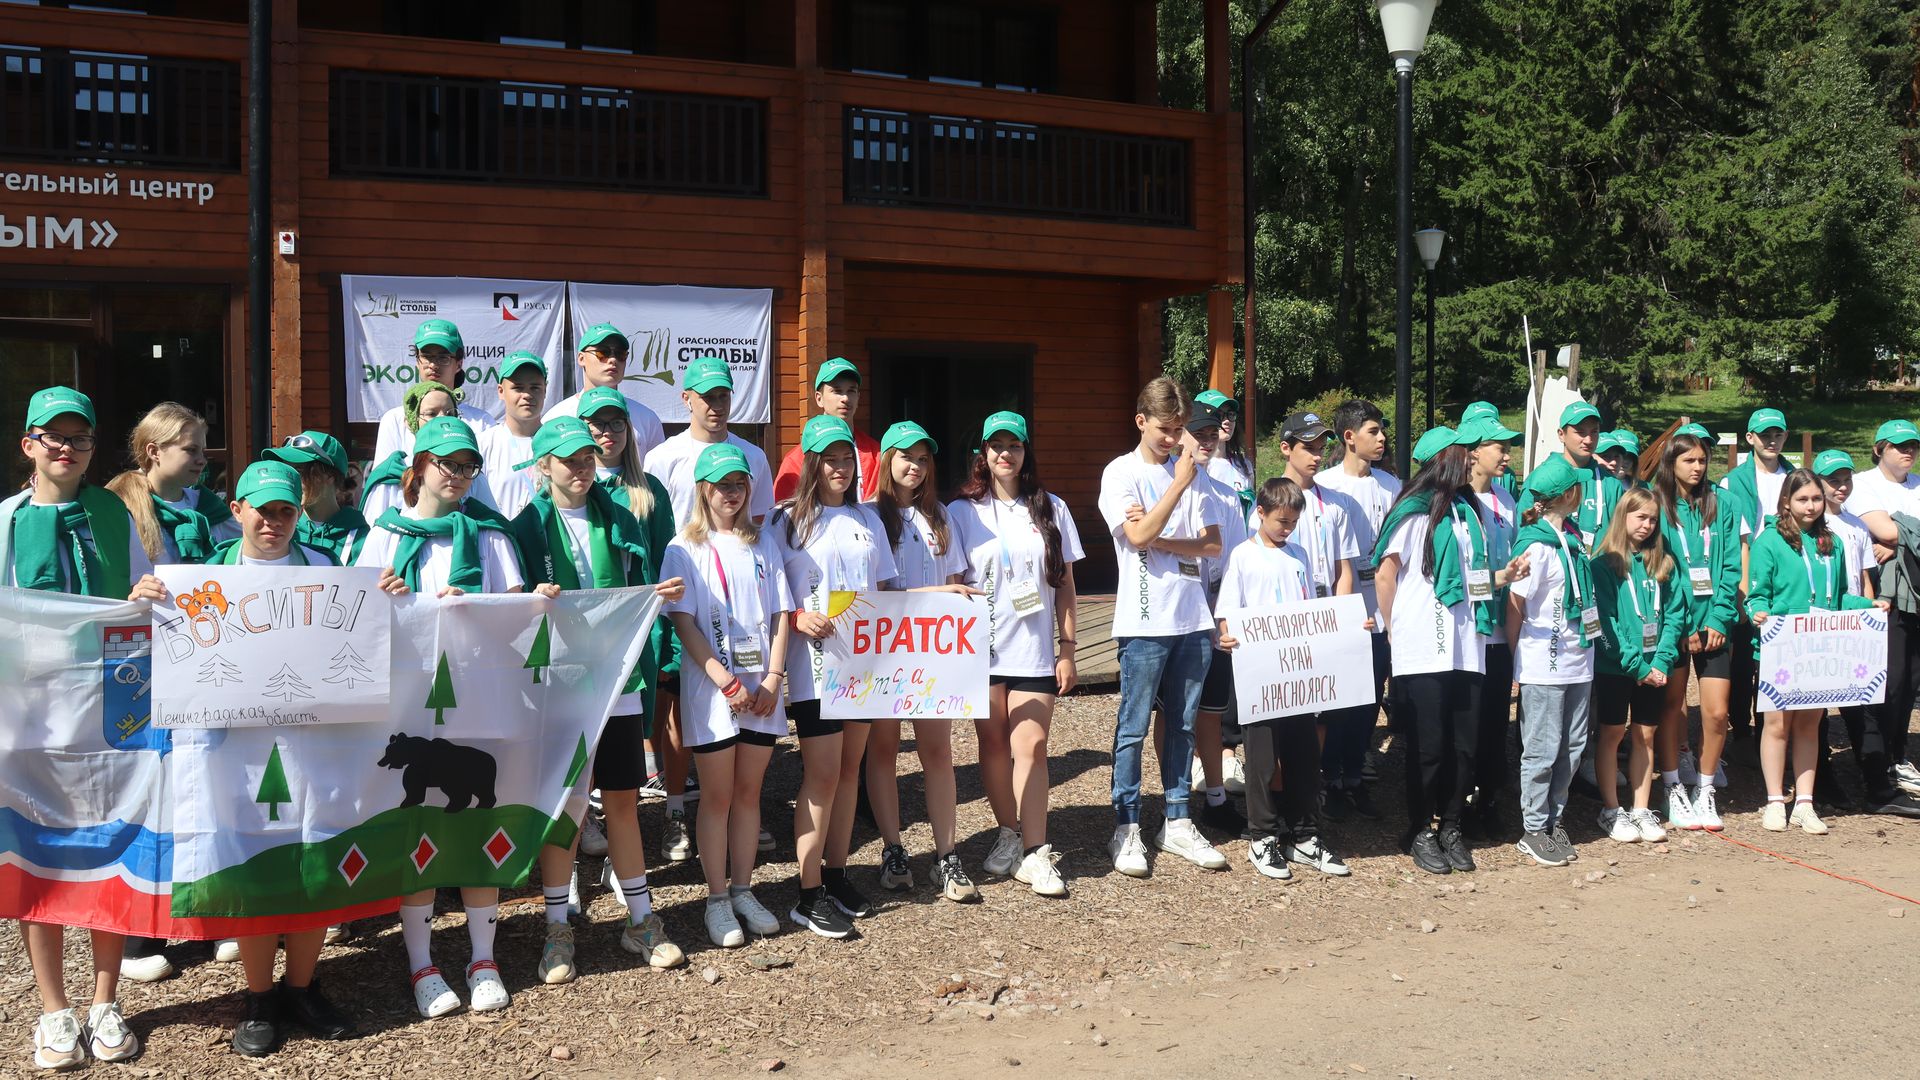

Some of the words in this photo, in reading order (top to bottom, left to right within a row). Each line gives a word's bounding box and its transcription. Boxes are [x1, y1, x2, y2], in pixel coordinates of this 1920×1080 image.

[130, 179, 214, 205] центр
[400, 304, 437, 312] СТОЛБЫ
[523, 302, 552, 311] РУСАЛ
[678, 337, 757, 346] КРАСНОЯРСКИЕ
[678, 347, 757, 363] СТОЛБЫ
[158, 584, 366, 664] БОКСИТЫ
[854, 614, 977, 655] БРАТСК
[1242, 608, 1338, 643] КРАСНОЯРСКИЙ
[1279, 641, 1313, 674] КРАЙ
[1793, 656, 1851, 683] РАЙОН
[825, 668, 936, 706] Иркутская
[156, 703, 265, 728] Ленинградская
[893, 695, 973, 716] область
